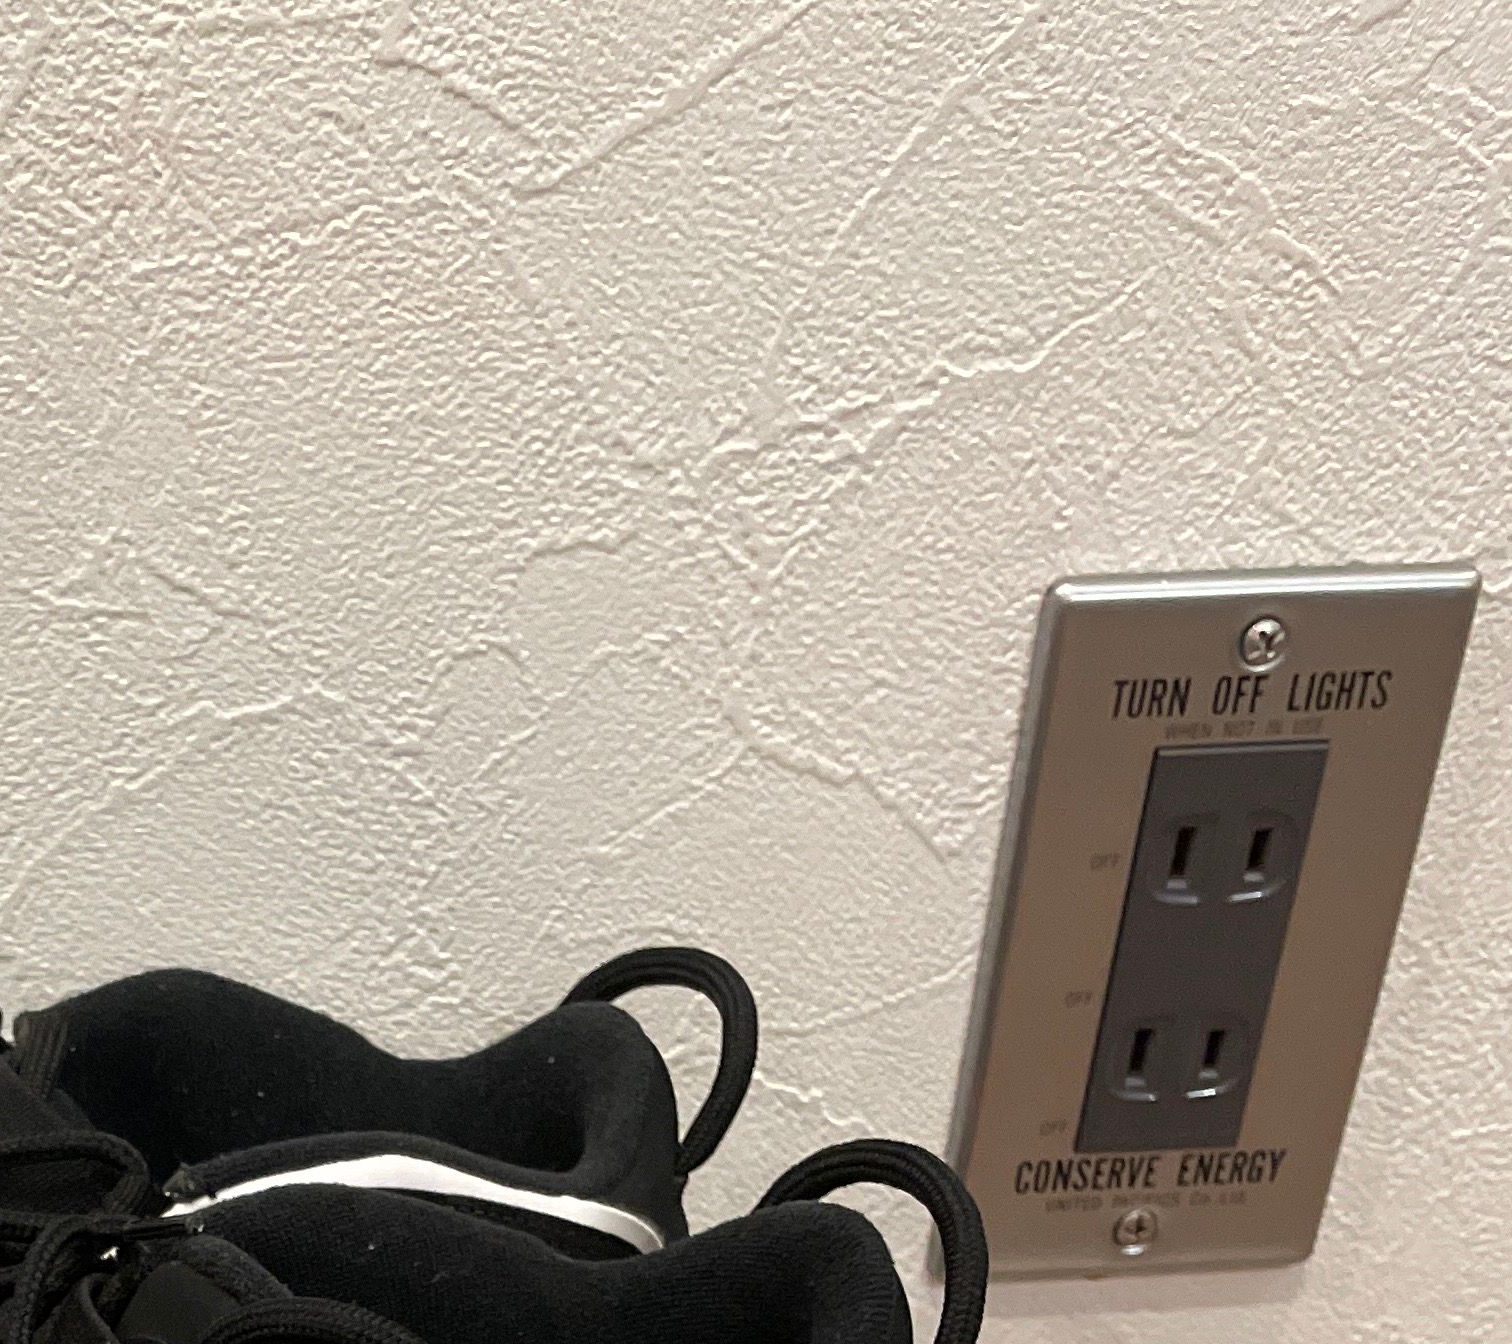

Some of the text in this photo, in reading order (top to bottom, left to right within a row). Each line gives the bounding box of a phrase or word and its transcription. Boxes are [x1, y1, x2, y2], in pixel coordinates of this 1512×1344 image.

[1111, 669, 1394, 721] TURN OFF LIGHTS
[1014, 1148, 1289, 1196] CONSERVE ENERGY
